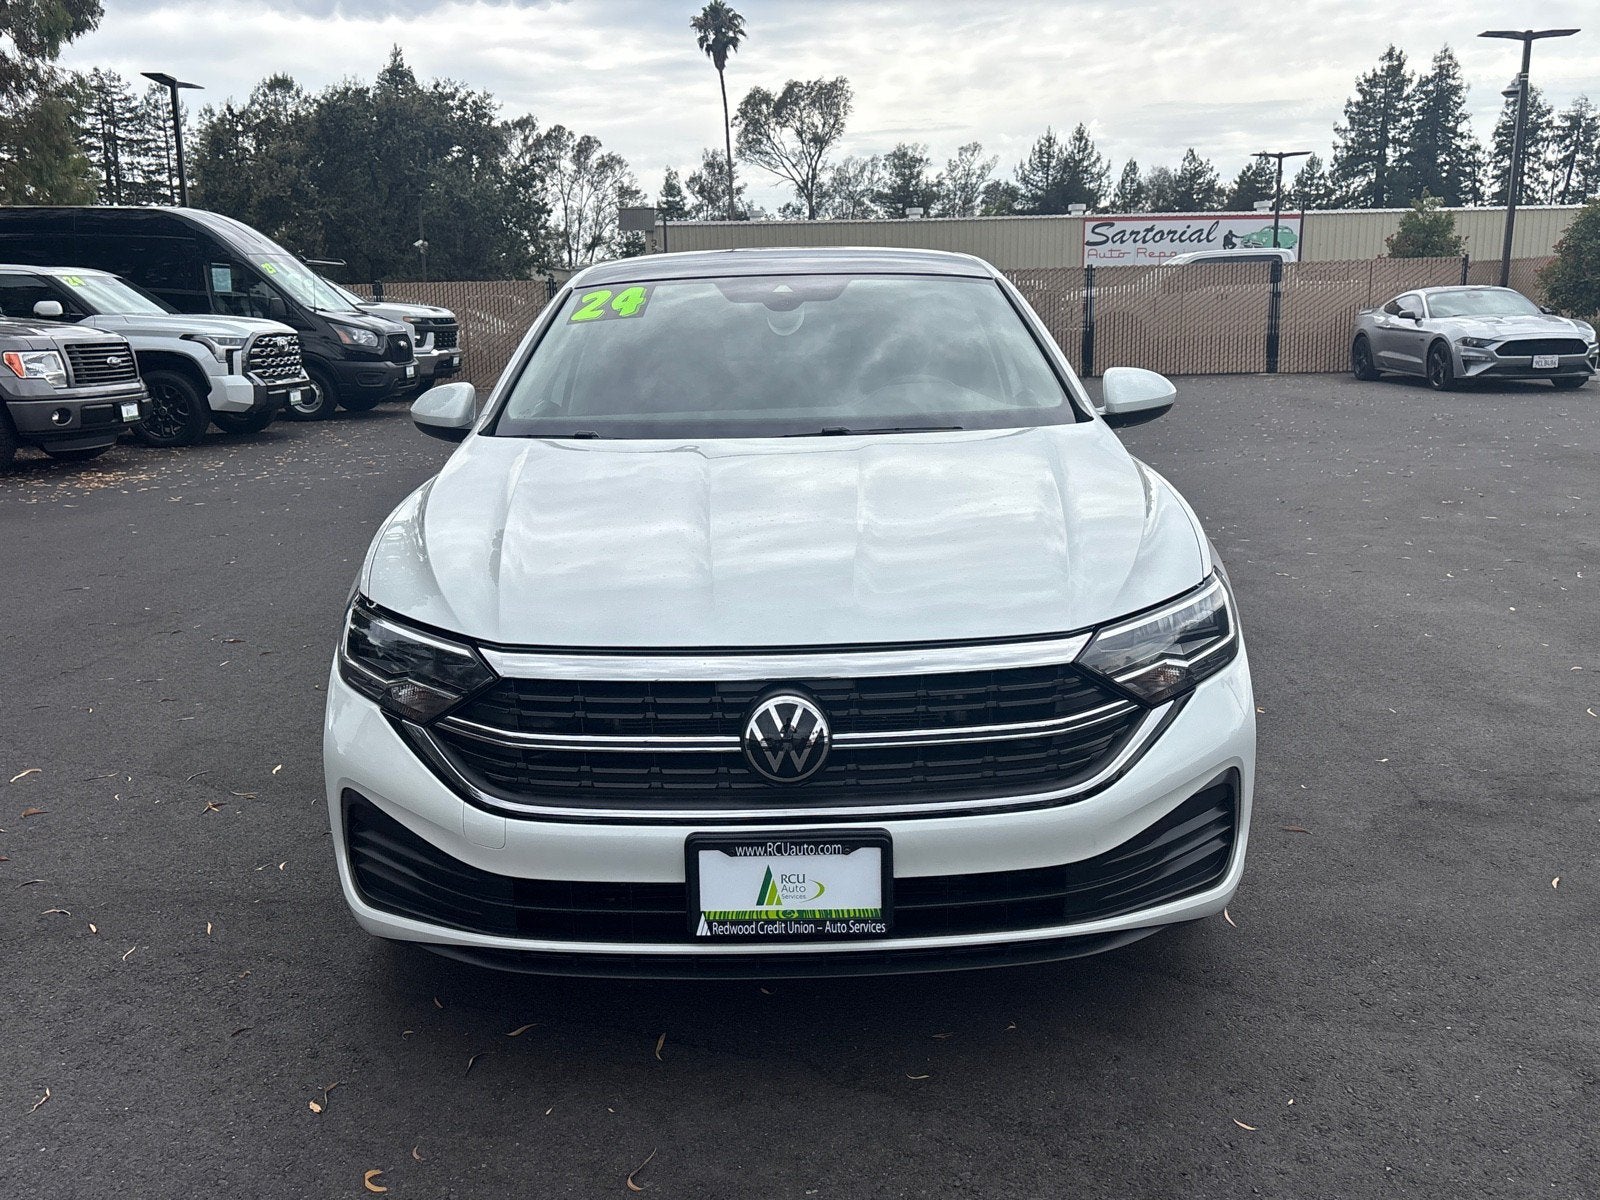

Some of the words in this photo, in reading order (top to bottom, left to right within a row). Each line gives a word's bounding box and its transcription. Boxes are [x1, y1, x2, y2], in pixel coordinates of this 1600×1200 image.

[1085, 220, 1220, 246] Sartorial
[1087, 248, 1131, 259] Auto
[1137, 247, 1192, 265] Repa
[570, 286, 648, 321] 24
[735, 842, 843, 857] www.RCUauto.com
[780, 873, 806, 884] RCU
[780, 883, 806, 893] Auto
[712, 921, 756, 935] Redwood
[757, 921, 785, 934] Credit
[787, 920, 815, 934] Union
[825, 920, 847, 933] Auto
[849, 919, 886, 933] Services
